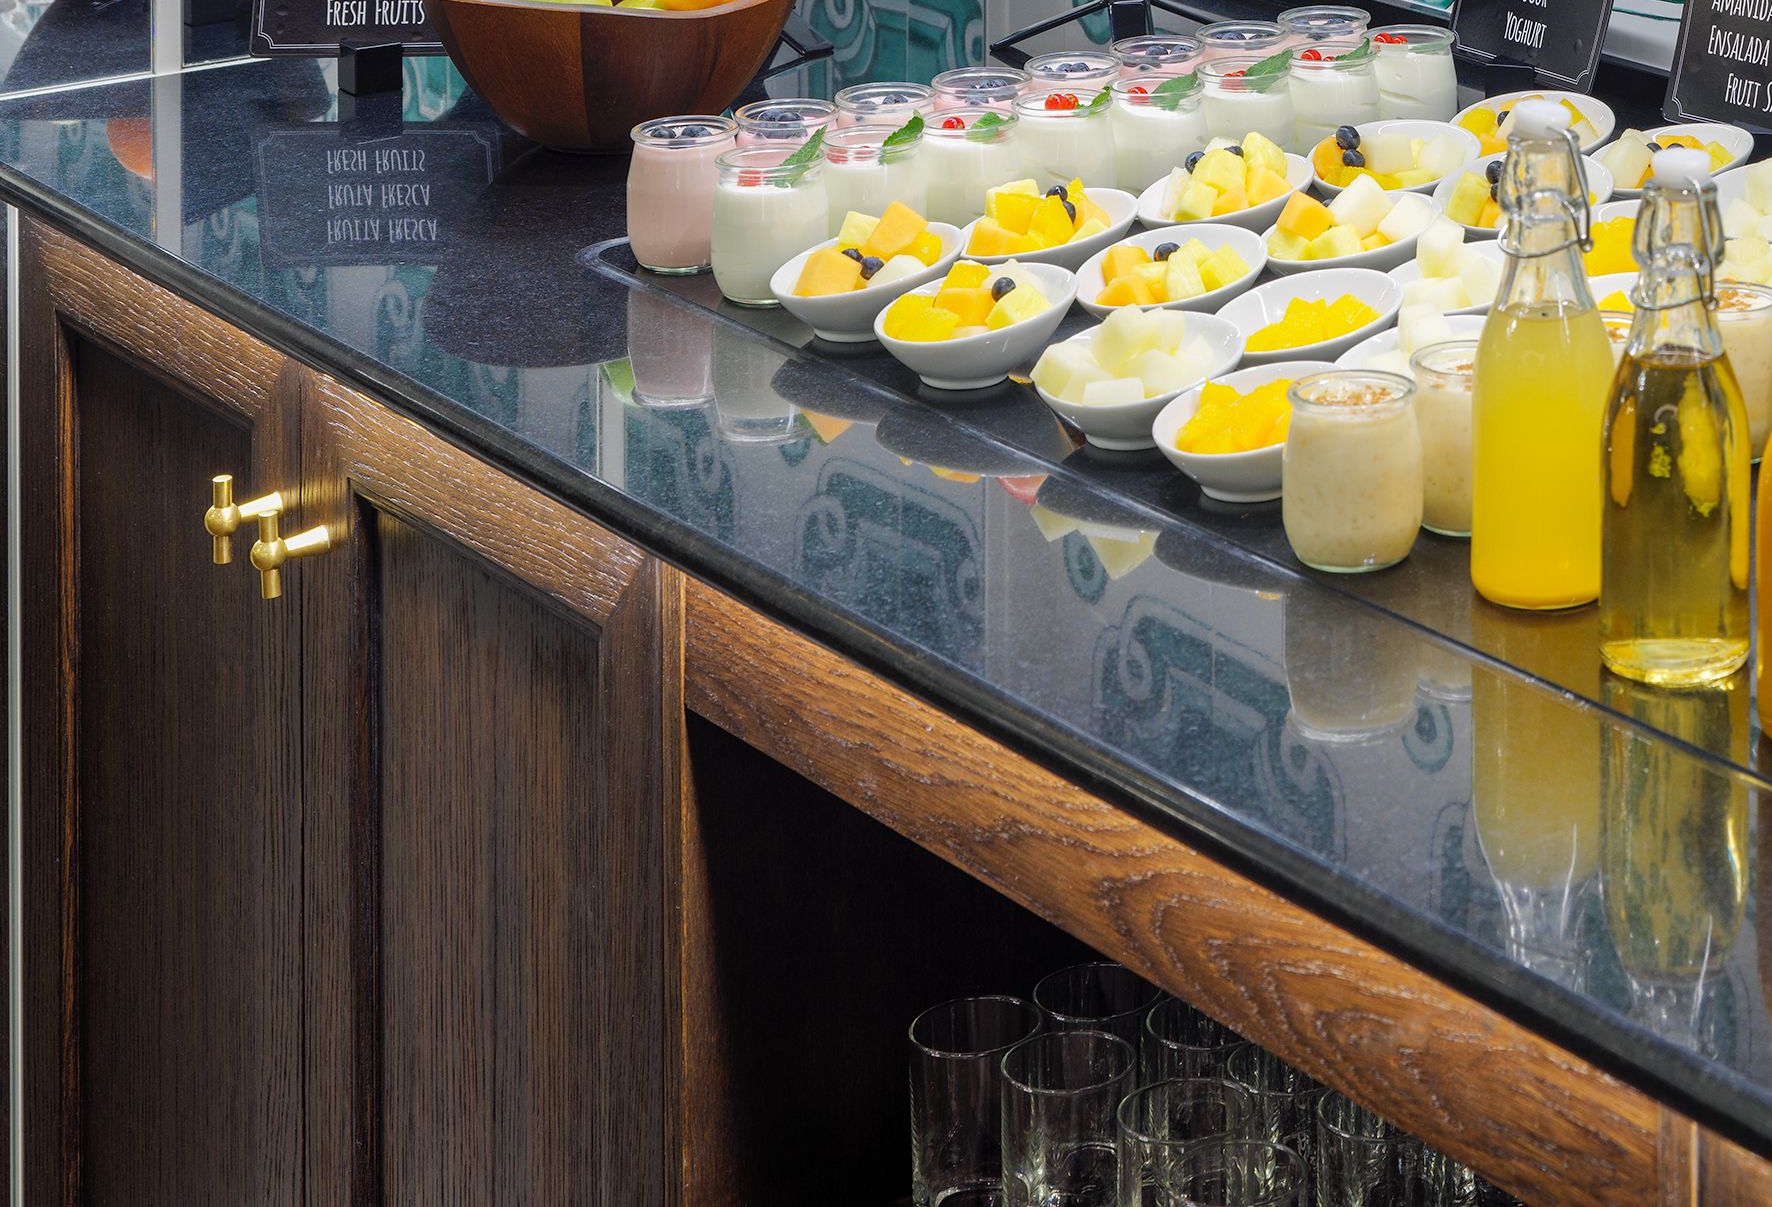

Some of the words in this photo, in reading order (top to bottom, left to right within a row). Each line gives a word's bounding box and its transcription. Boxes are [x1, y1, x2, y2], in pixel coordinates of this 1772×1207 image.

[1504, 11, 1547, 49] YOGHURT
[1707, 25, 1770, 67] ENSALADA
[1725, 73, 1761, 109] FRUIT
